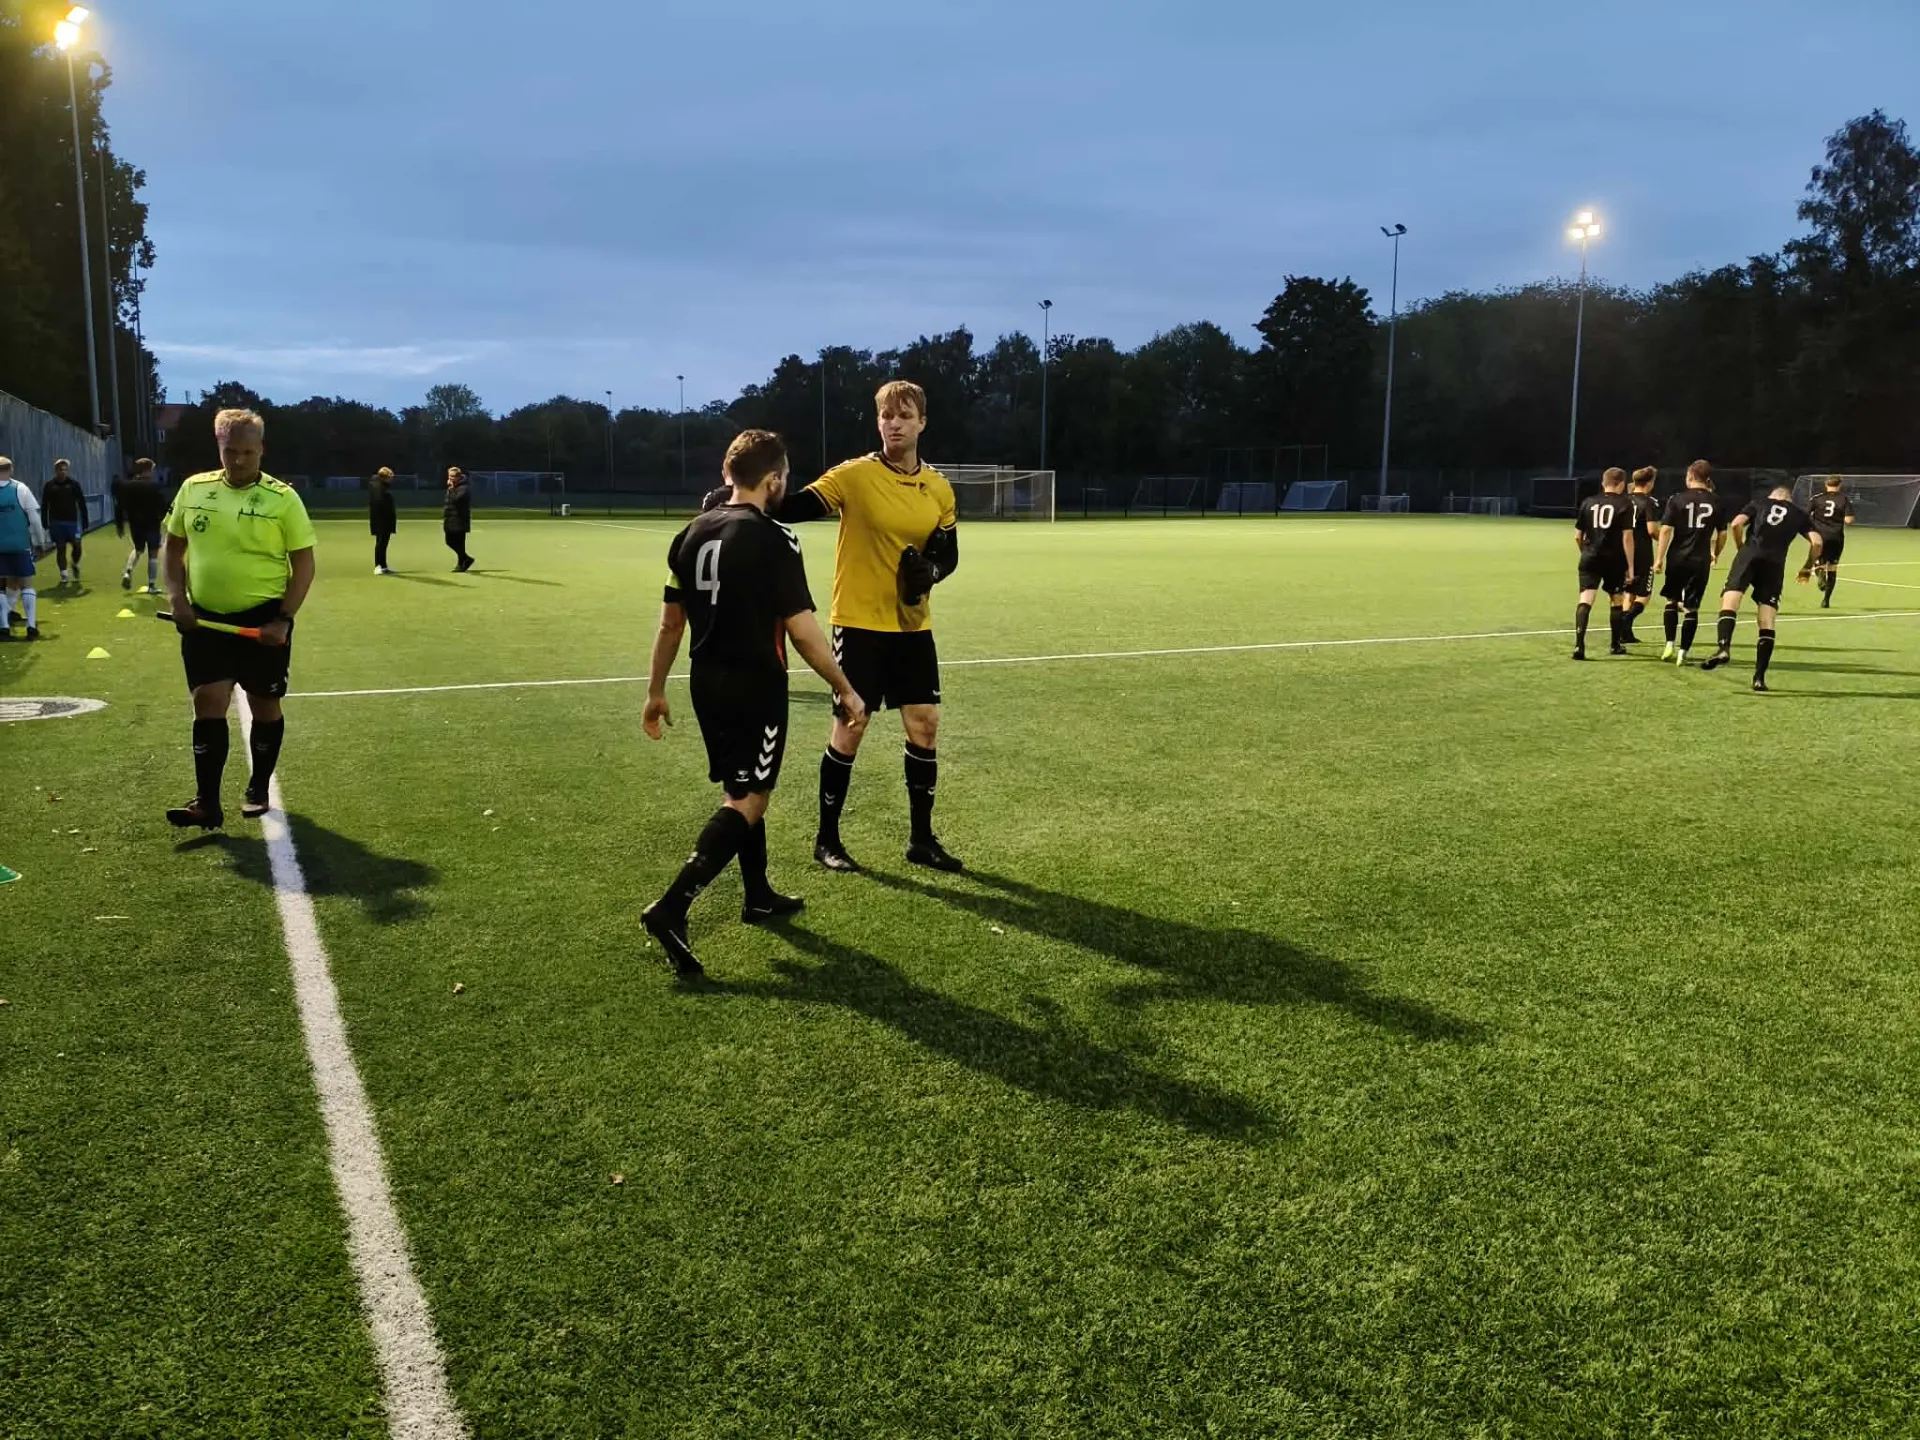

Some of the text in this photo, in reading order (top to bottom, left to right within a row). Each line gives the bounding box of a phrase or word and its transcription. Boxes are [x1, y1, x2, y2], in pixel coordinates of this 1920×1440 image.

[1590, 504, 1615, 529] 10
[1685, 502, 1713, 528] 12
[1766, 504, 1787, 525] 8
[1823, 500, 1836, 517] 3
[695, 539, 722, 605] 4
